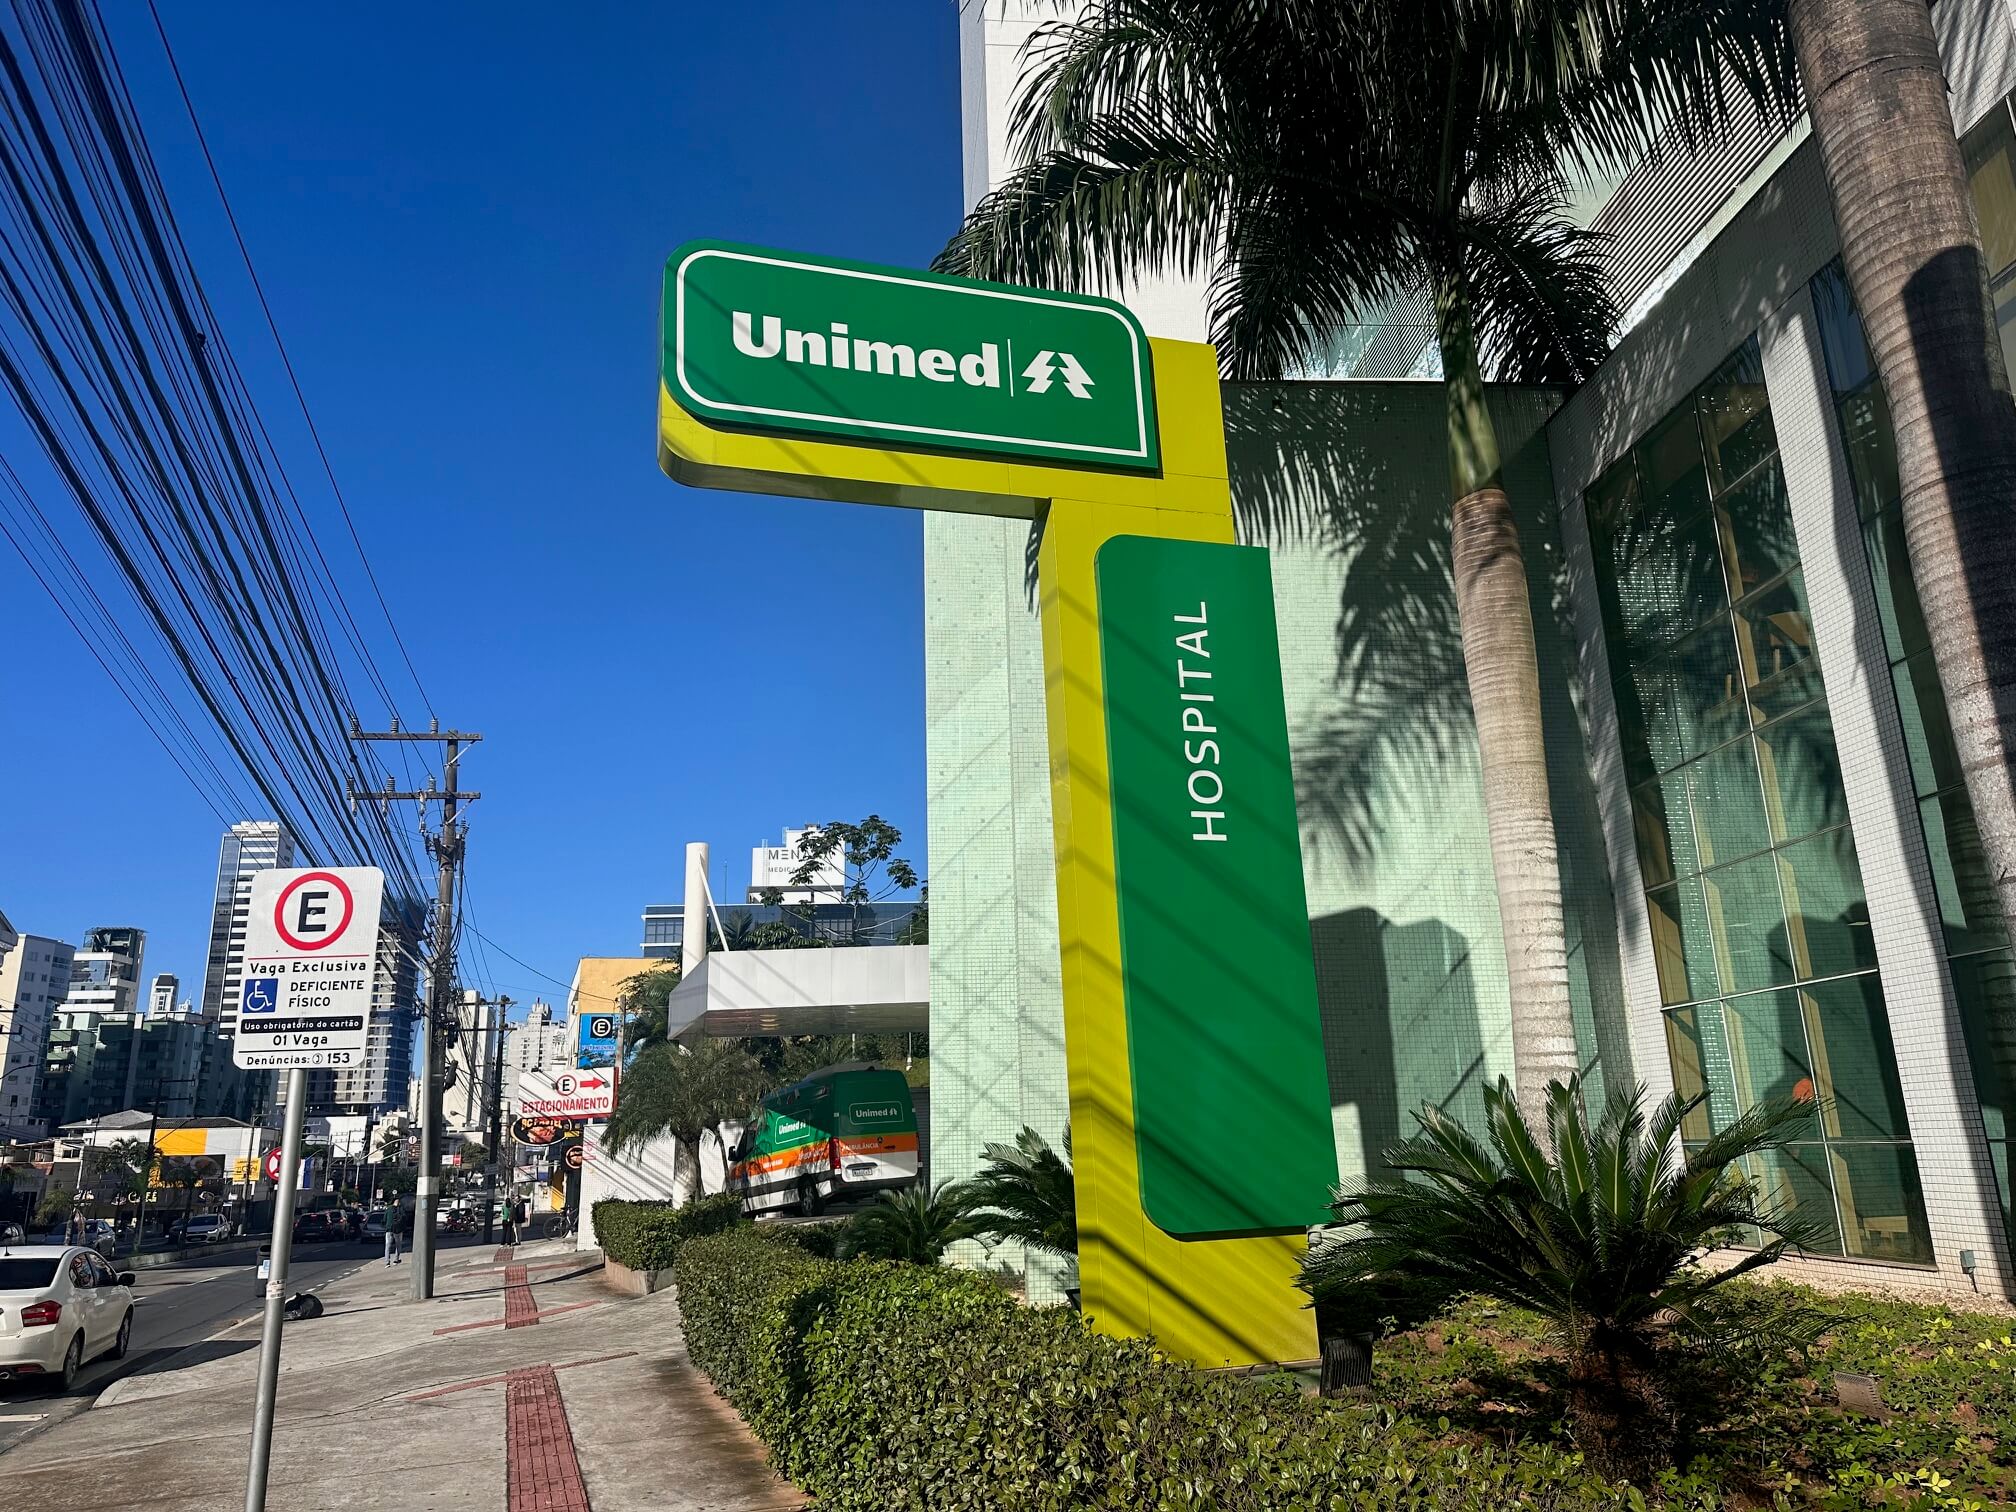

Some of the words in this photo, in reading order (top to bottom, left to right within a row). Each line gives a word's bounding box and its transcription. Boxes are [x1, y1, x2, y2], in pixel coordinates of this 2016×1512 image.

[732, 311, 1000, 388] Unimed
[1173, 601, 1228, 842] HOSPITAL
[298, 891, 330, 933] E
[250, 962, 286, 977] Vaga
[292, 960, 367, 973] Exclusiva
[290, 980, 365, 992] DEFICIENTE
[288, 995, 331, 1008] FÍSICO
[244, 1022, 261, 1030] Uso
[263, 1020, 314, 1031] obrigatório
[330, 1019, 360, 1028] cartão
[597, 1022, 606, 1033] E
[293, 1034, 329, 1047] Vaga
[246, 1053, 311, 1066] Denúncias:
[327, 1052, 351, 1065] 153
[562, 1078, 571, 1092] E
[521, 1096, 609, 1114] ESTACIONAMENTO
[855, 1108, 888, 1118] Unimed
[778, 1121, 800, 1135] Unimed
